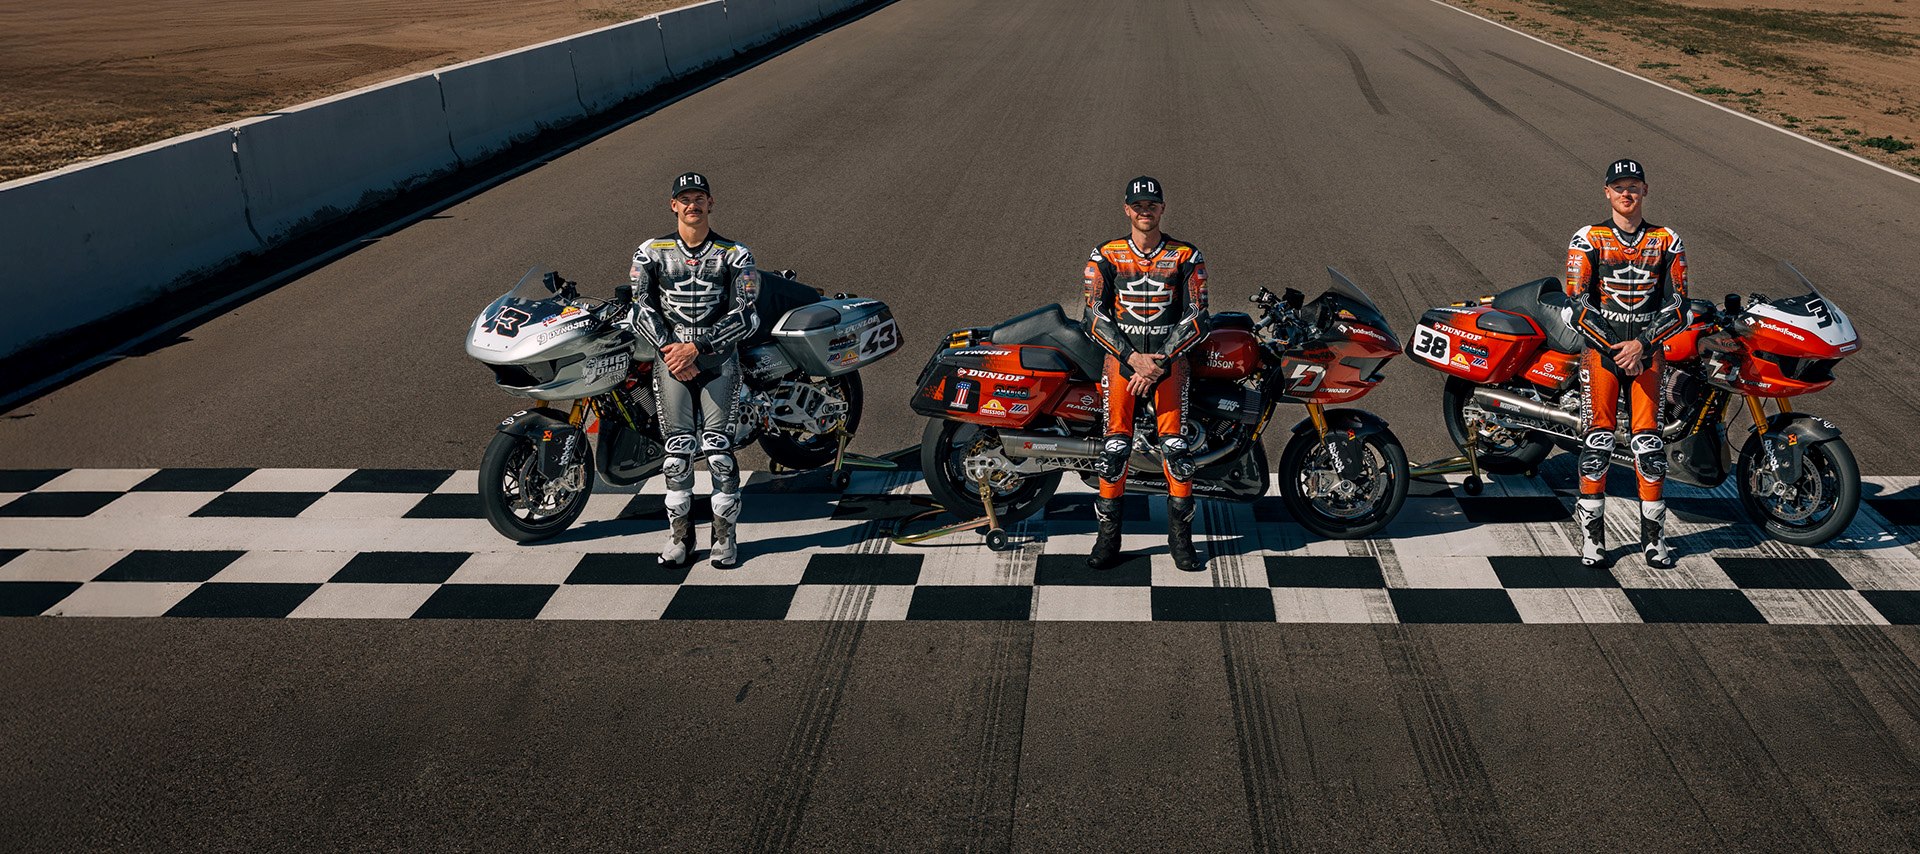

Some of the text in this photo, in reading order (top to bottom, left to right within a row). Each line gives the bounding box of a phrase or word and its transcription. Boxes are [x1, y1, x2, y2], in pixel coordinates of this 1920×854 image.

[1614, 161, 1637, 174] H-D
[679, 174, 701, 187] H-D
[1133, 181, 1155, 194] H-D
[549, 319, 591, 339] DYNOJET
[844, 314, 880, 334] DUNLOP
[861, 323, 896, 355] 43
[1440, 324, 1483, 341] DUNLOP
[1416, 329, 1448, 359] 38
[597, 353, 627, 368] BIG
[968, 368, 1026, 382] DUNLOP
[1531, 369, 1565, 381] RACING
